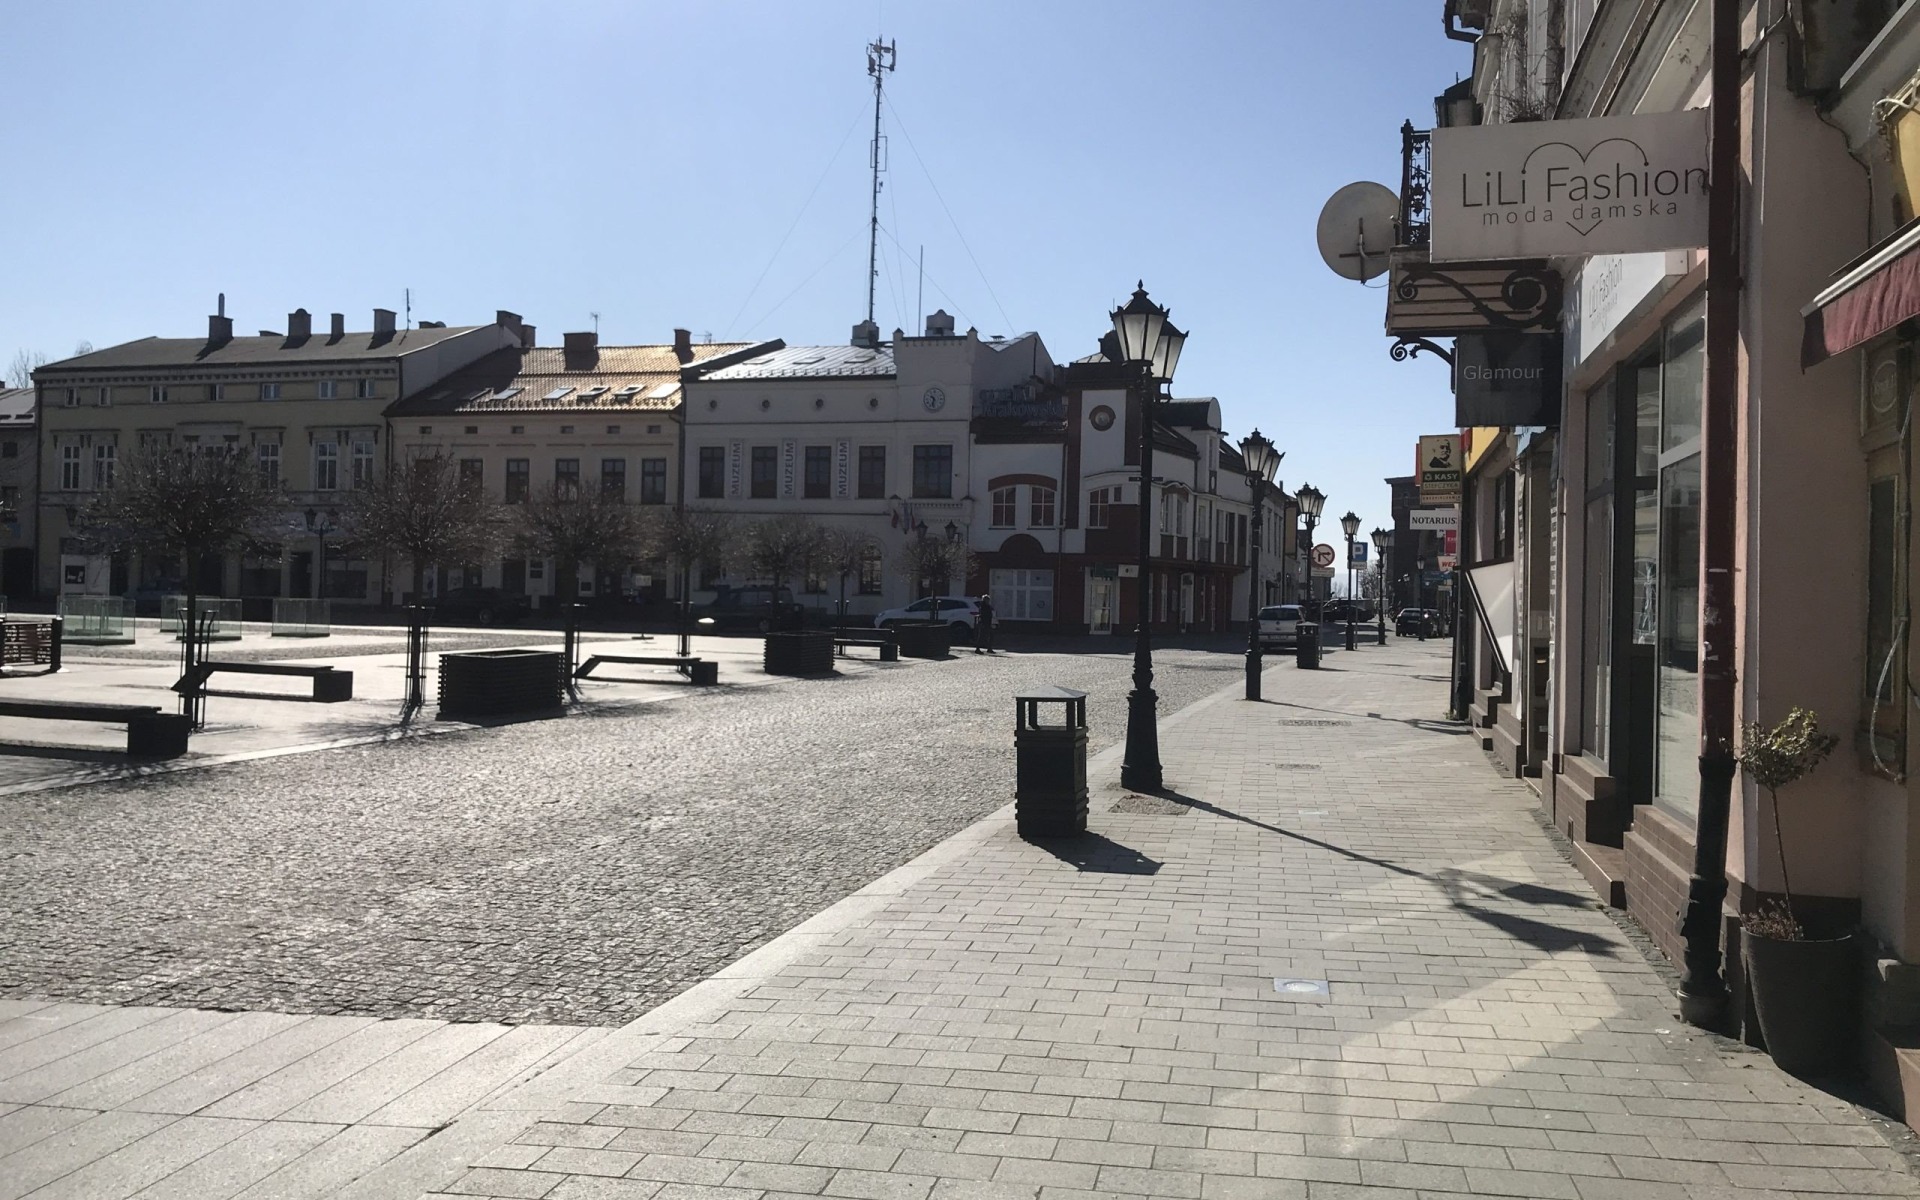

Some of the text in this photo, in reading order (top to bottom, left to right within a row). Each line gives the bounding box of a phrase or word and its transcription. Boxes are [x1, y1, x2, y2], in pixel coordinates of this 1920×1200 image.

[1462, 162, 1709, 208] LiLi Fashion
[1483, 200, 1677, 226] moda damska
[1463, 365, 1544, 380] Glamour
[731, 442, 741, 495] MUZEUM
[784, 442, 794, 495] MUZEUM
[838, 441, 848, 495] MUZEUM
[1434, 473, 1457, 481] KASY
[1412, 516, 1457, 525] NOTARIUS
[1353, 544, 1364, 559] P
